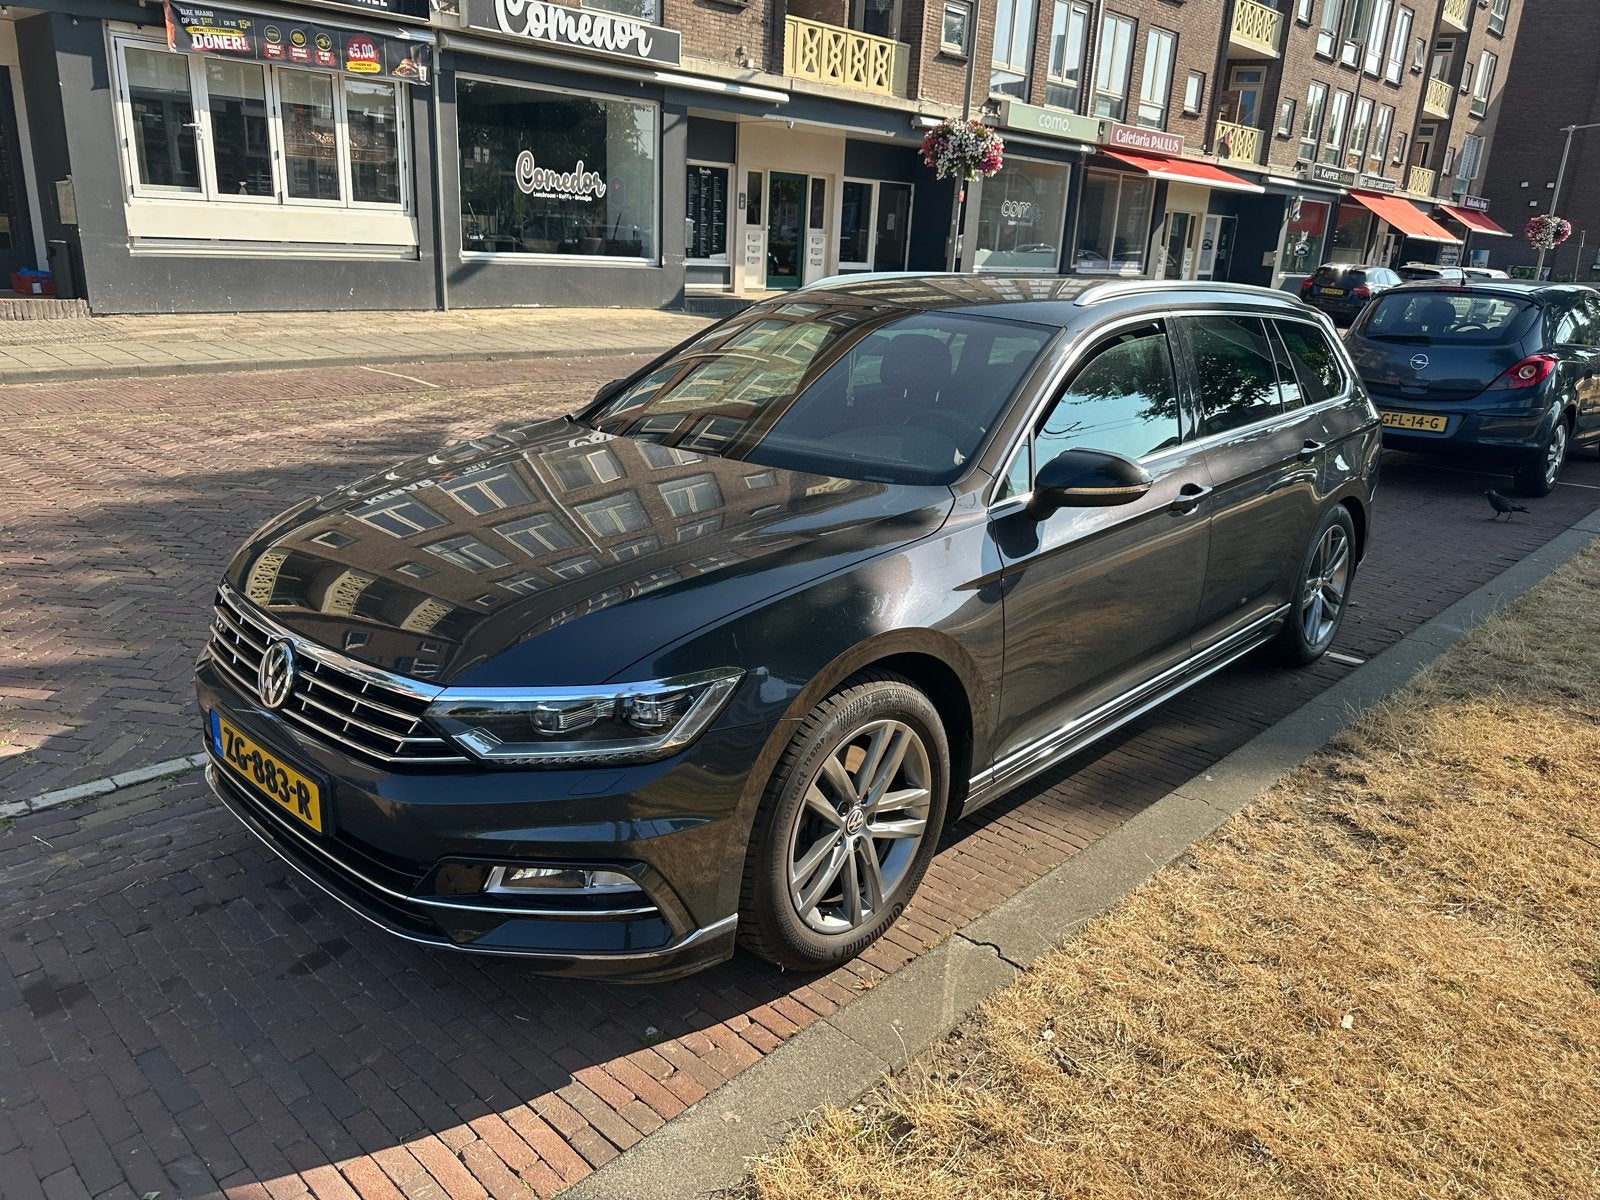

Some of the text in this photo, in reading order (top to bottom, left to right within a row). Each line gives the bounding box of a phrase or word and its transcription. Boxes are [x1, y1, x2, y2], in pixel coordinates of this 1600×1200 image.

[180, 8, 214, 18] ELKE MAAND
[192, 33, 247, 51] DÖNER!
[349, 43, 375, 60] €5,00
[1038, 113, 1072, 133] como.
[1116, 129, 1150, 147] Cafetaria
[515, 150, 606, 198] Comedor
[1320, 168, 1339, 181] KAPPER
[1382, 413, 1440, 429] GFL-14-G
[810, 743, 822, 758] 870
[223, 726, 313, 821] ZG-883-R
